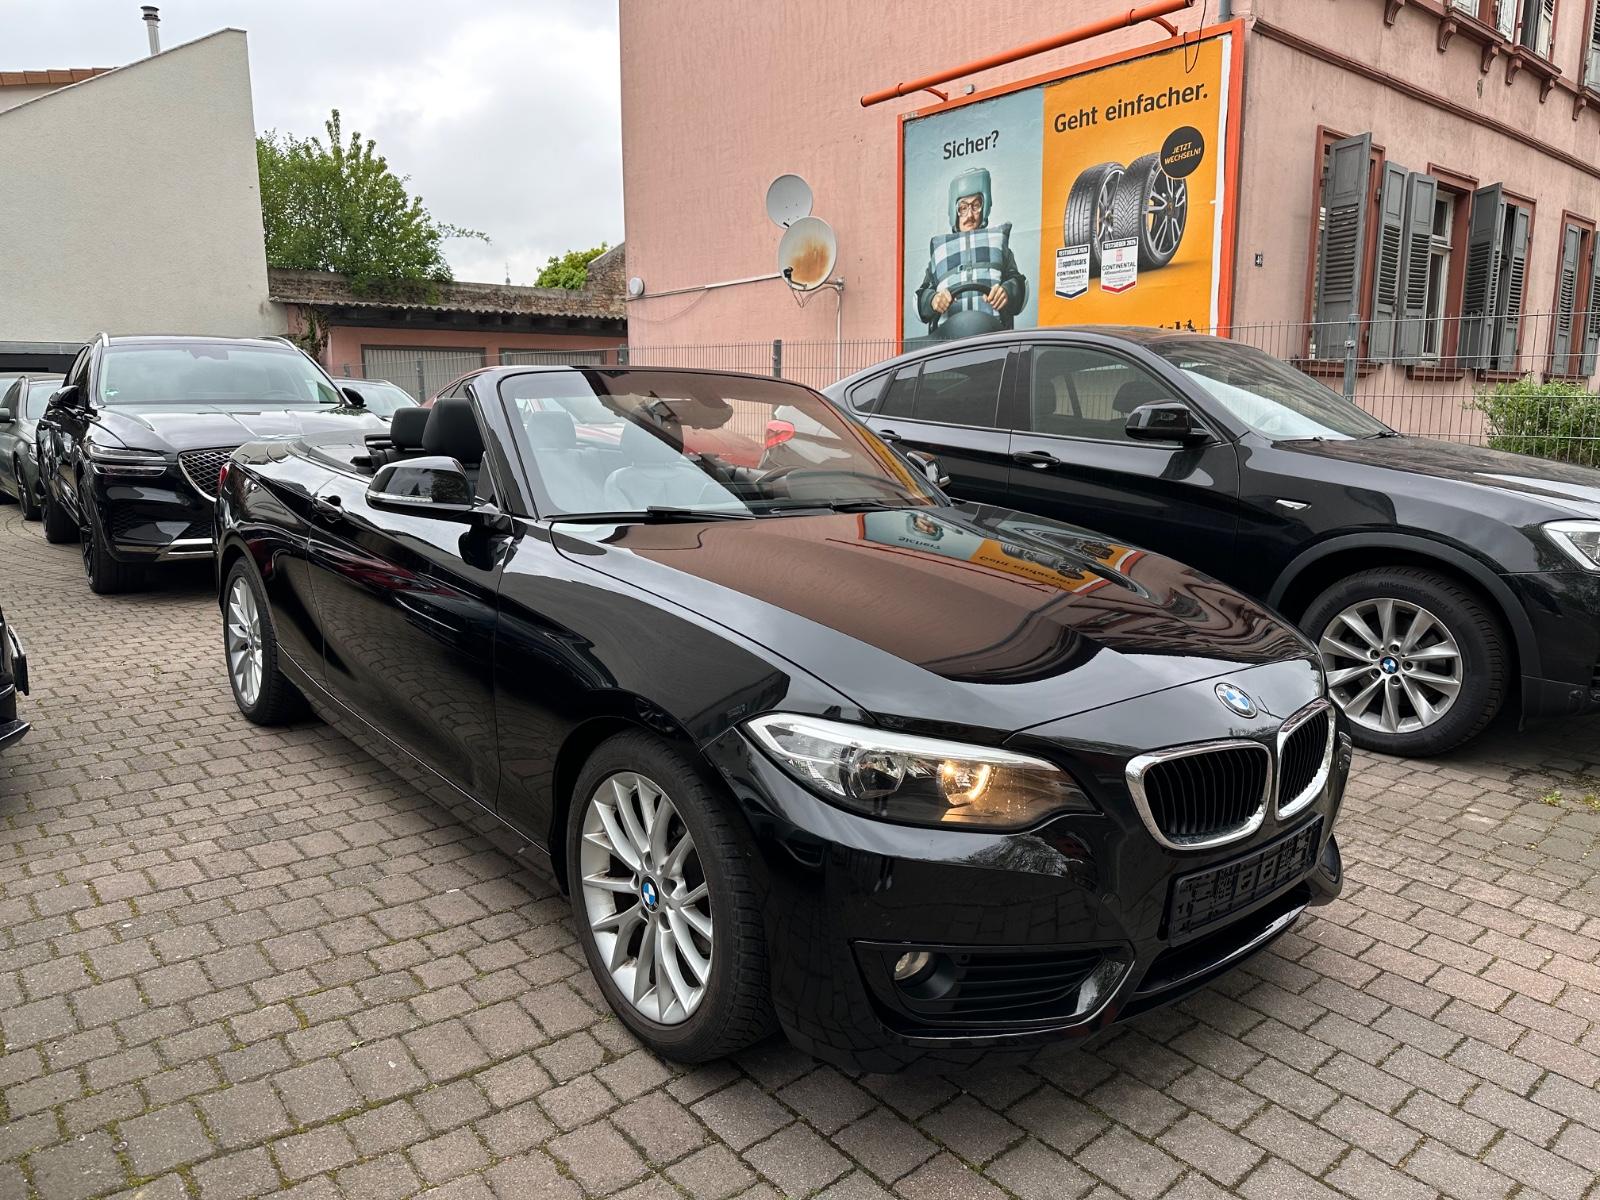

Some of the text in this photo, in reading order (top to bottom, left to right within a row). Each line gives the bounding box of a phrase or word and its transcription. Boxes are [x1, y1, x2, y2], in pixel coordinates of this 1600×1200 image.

[1054, 81, 1208, 133] Geht einfacher.
[943, 130, 1000, 160] Sicher?
[1172, 142, 1192, 154] JETZT
[1164, 147, 1202, 165] WECHSELN!
[1102, 261, 1136, 271] CONTINENTAL
